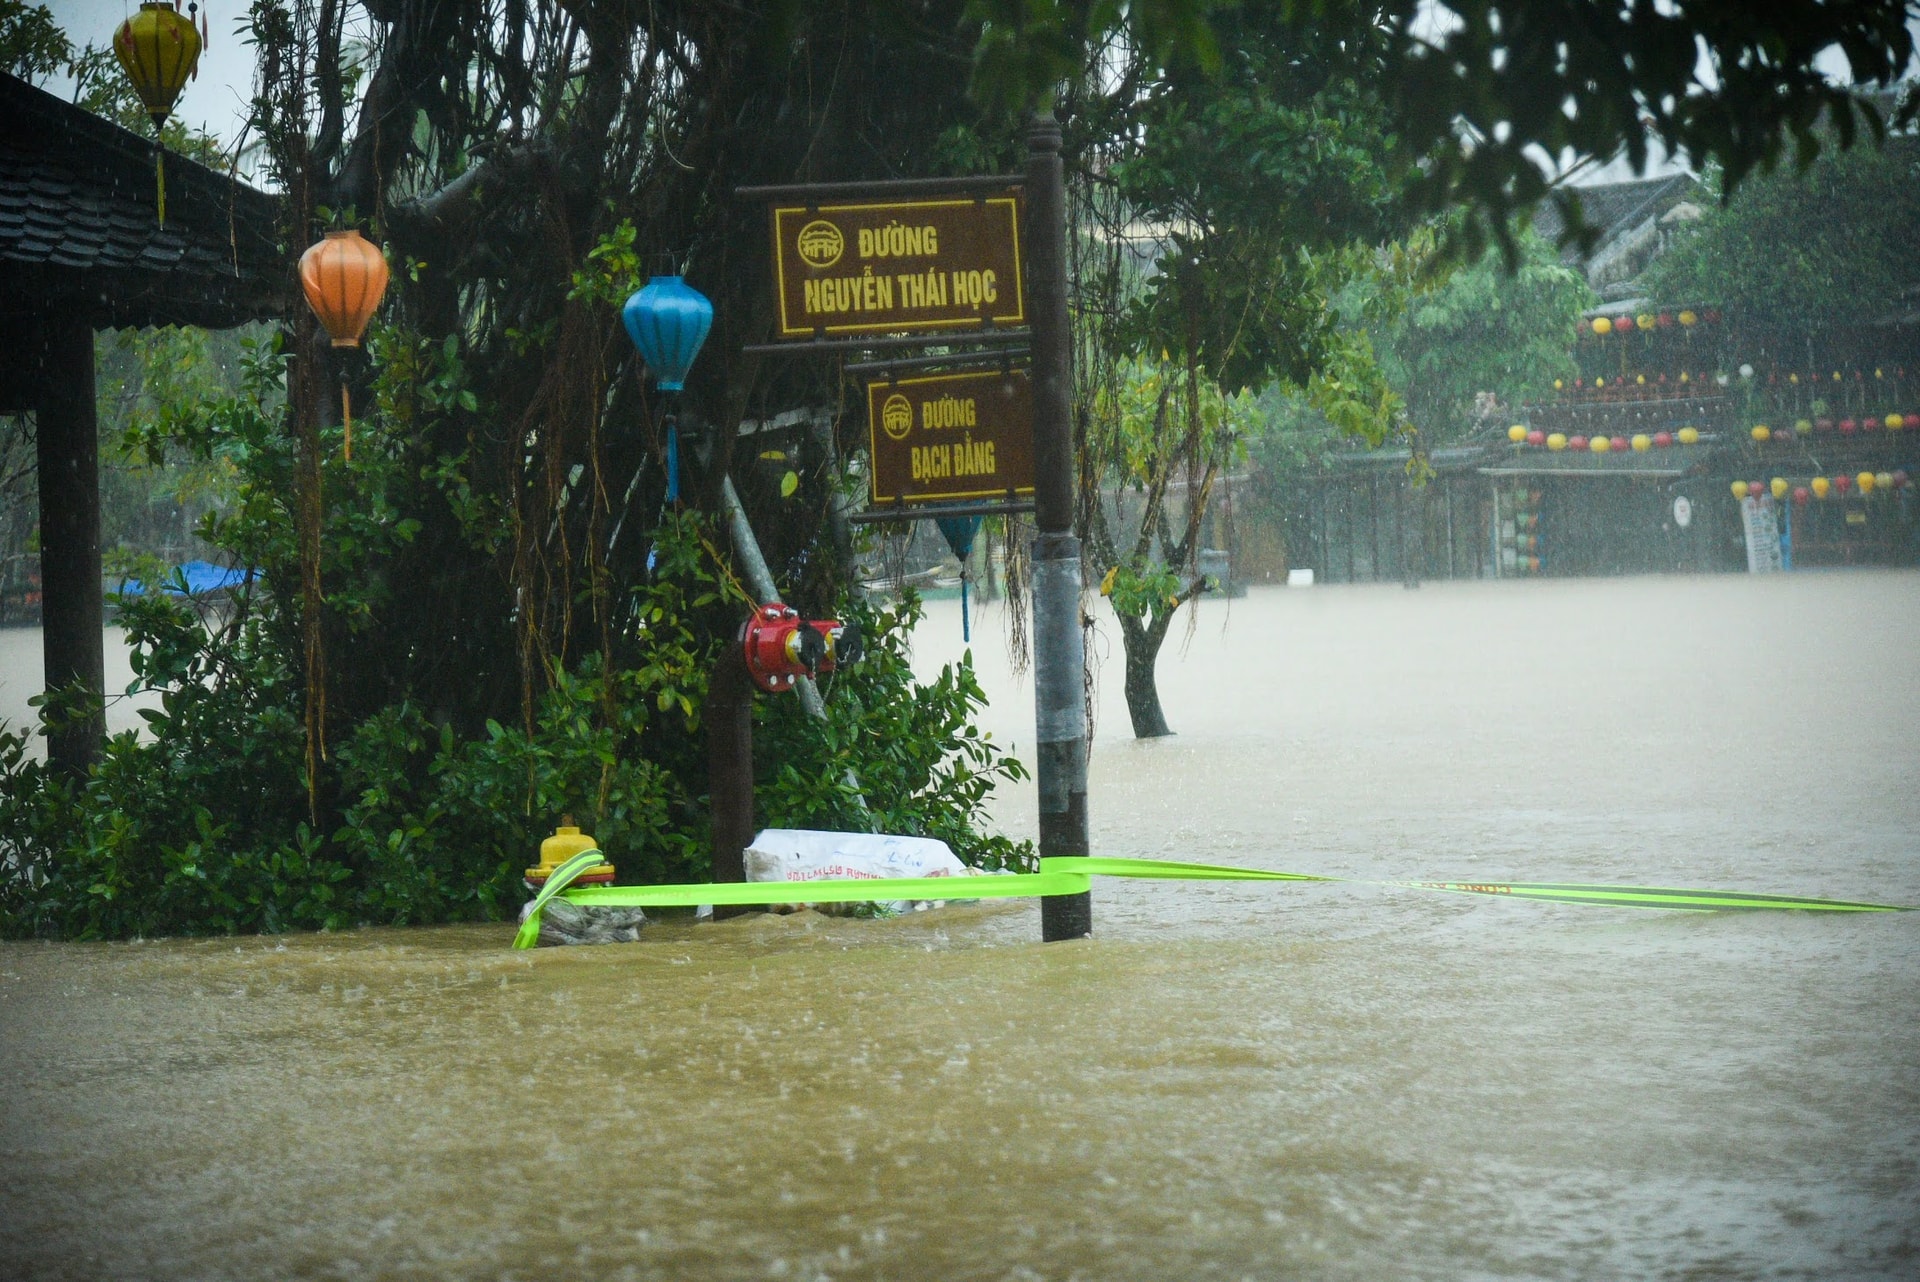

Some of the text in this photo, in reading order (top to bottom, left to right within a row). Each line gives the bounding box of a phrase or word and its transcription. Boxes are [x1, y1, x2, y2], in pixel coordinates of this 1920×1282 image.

[858, 219, 938, 258] ĐƯỜNG
[804, 265, 997, 313] NGUYỄN THÁI HỌC
[922, 393, 976, 429] ĐƯỜNG
[911, 431, 996, 485] BẠCH ĐẰNG
